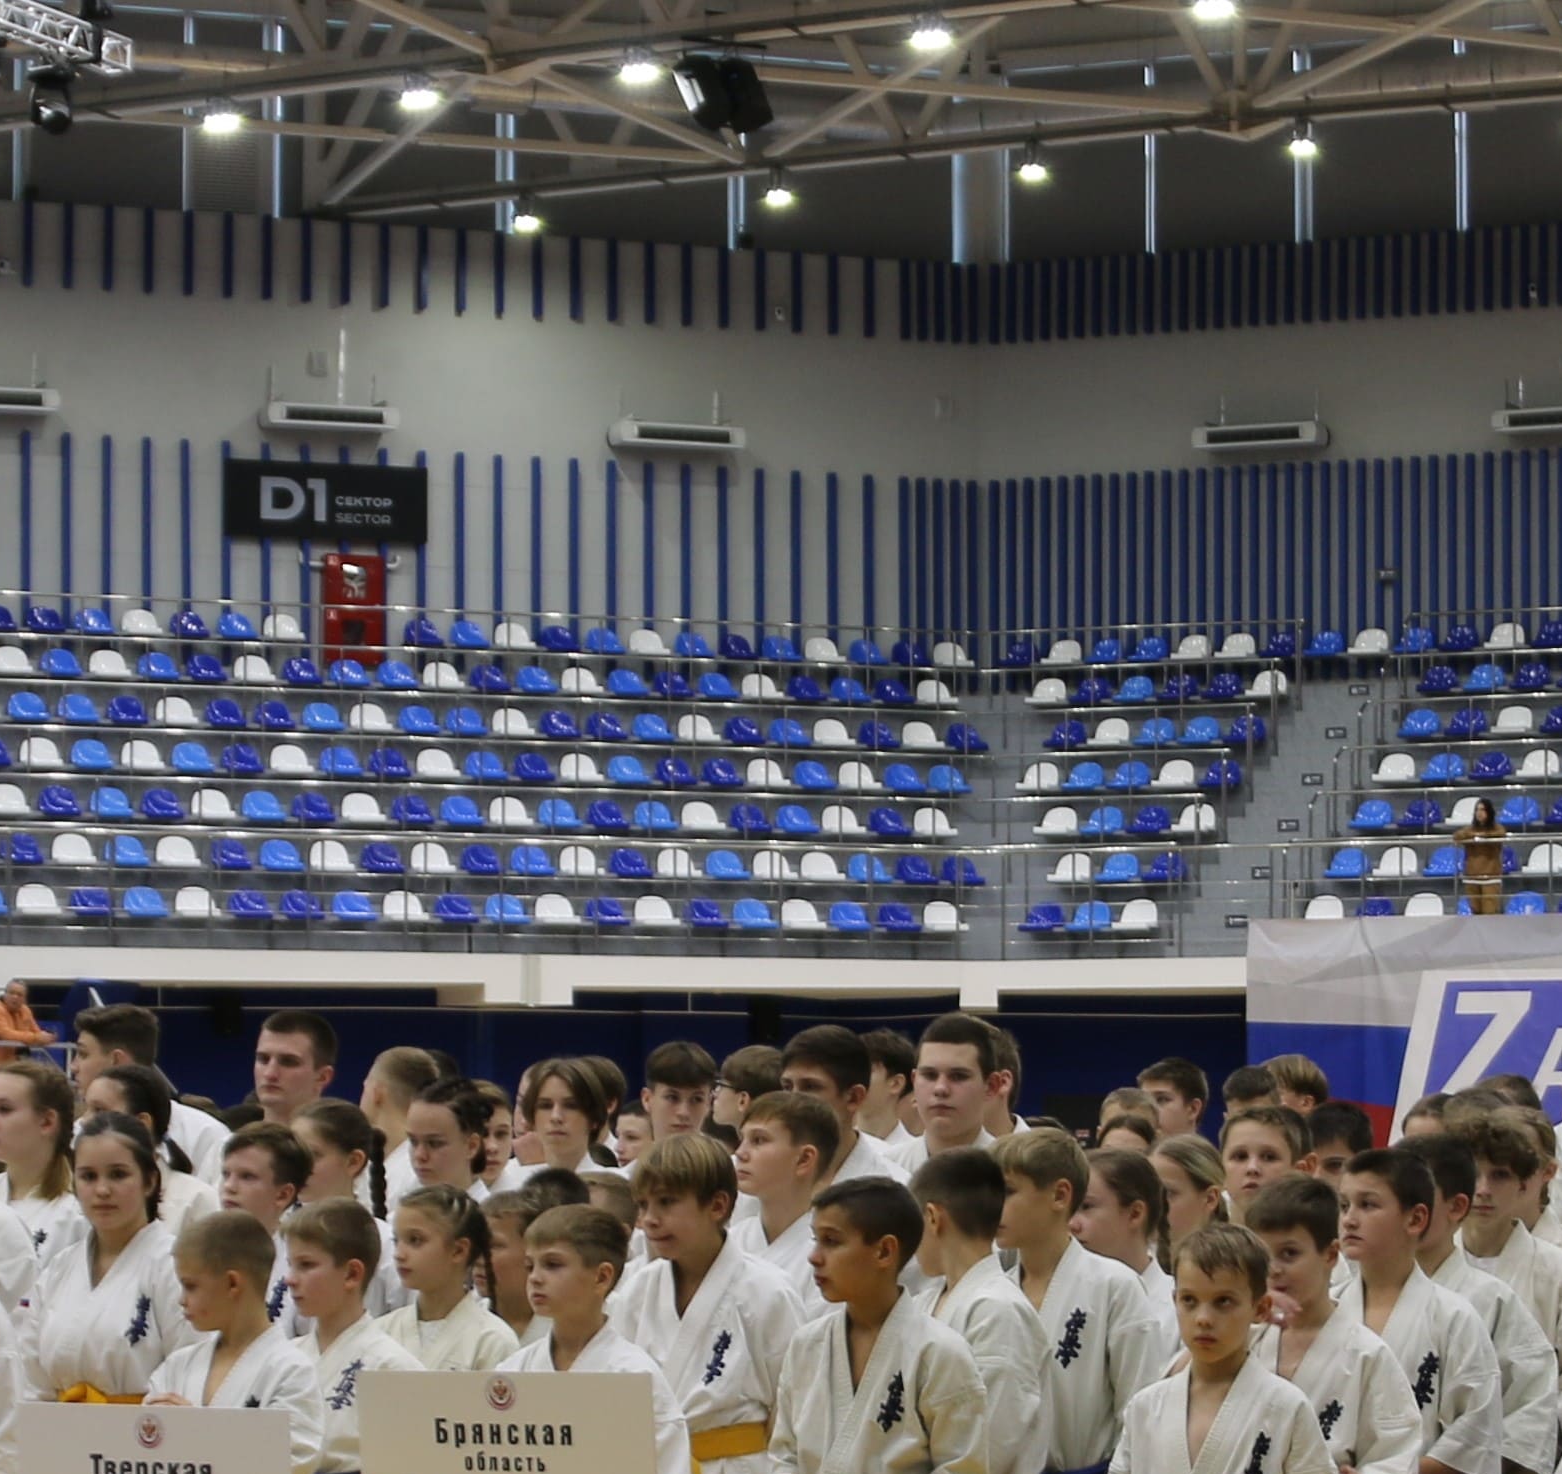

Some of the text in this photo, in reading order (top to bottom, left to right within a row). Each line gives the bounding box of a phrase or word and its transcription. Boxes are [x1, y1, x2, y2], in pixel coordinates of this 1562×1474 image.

[260, 476, 327, 522] D1
[335, 495, 393, 508] СЕКТОР
[335, 512, 392, 525] SECTOR
[434, 1418, 573, 1448] Брянская
[464, 1452, 546, 1472] область
